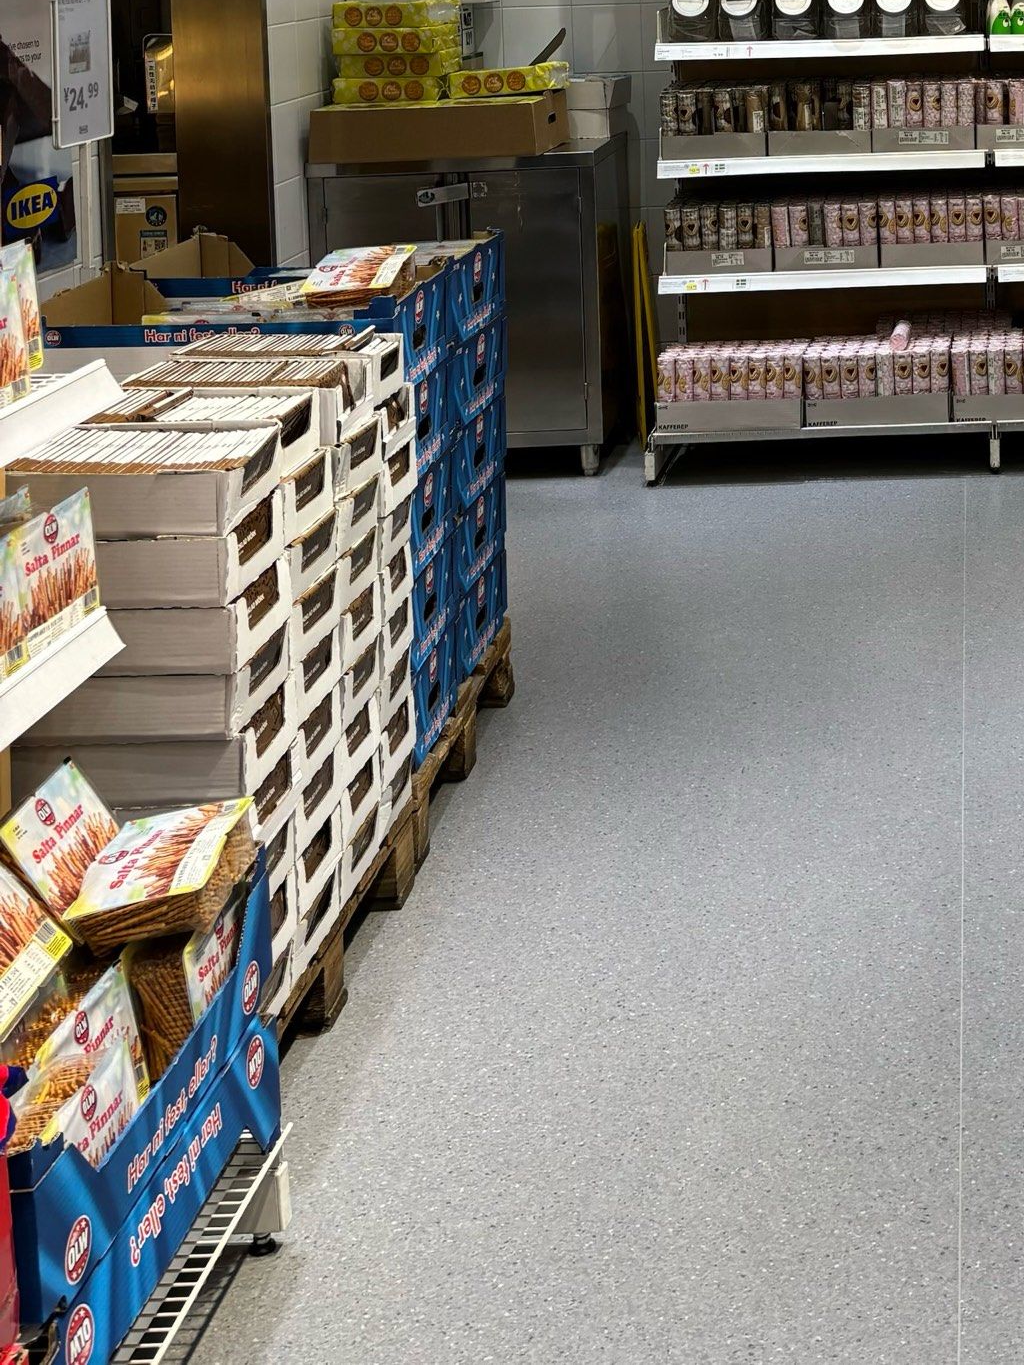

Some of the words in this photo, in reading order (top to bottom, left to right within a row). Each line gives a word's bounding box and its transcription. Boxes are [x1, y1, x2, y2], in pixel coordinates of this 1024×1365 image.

[64, 82, 99, 112] ¥24.99
[11, 191, 54, 220] IKEA
[145, 329, 170, 343] Har
[173, 328, 187, 342] ni
[25, 553, 49, 577] Salta
[51, 533, 81, 562] Pinnar
[32, 838, 57, 865] Salta
[54, 804, 85, 840] Pinnar
[110, 856, 138, 891] Salta
[198, 953, 220, 983] Salta
[244, 973, 259, 1000] OLW
[83, 1016, 114, 1055] Pinnar
[249, 1048, 263, 1077] OLW
[81, 1095, 96, 1115] OLW
[89, 1092, 123, 1135] Pinnar
[128, 1151, 152, 1194] Har
[152, 1126, 165, 1157] ni
[165, 1097, 188, 1135] fest,
[188, 1035, 217, 1099] eller?
[201, 1103, 222, 1148] Har
[190, 1139, 201, 1172] ni
[165, 1152, 191, 1203] fest,
[129, 1193, 165, 1267] eller?
[68, 1238, 88, 1271] OLW
[69, 1326, 93, 1364] OLW
